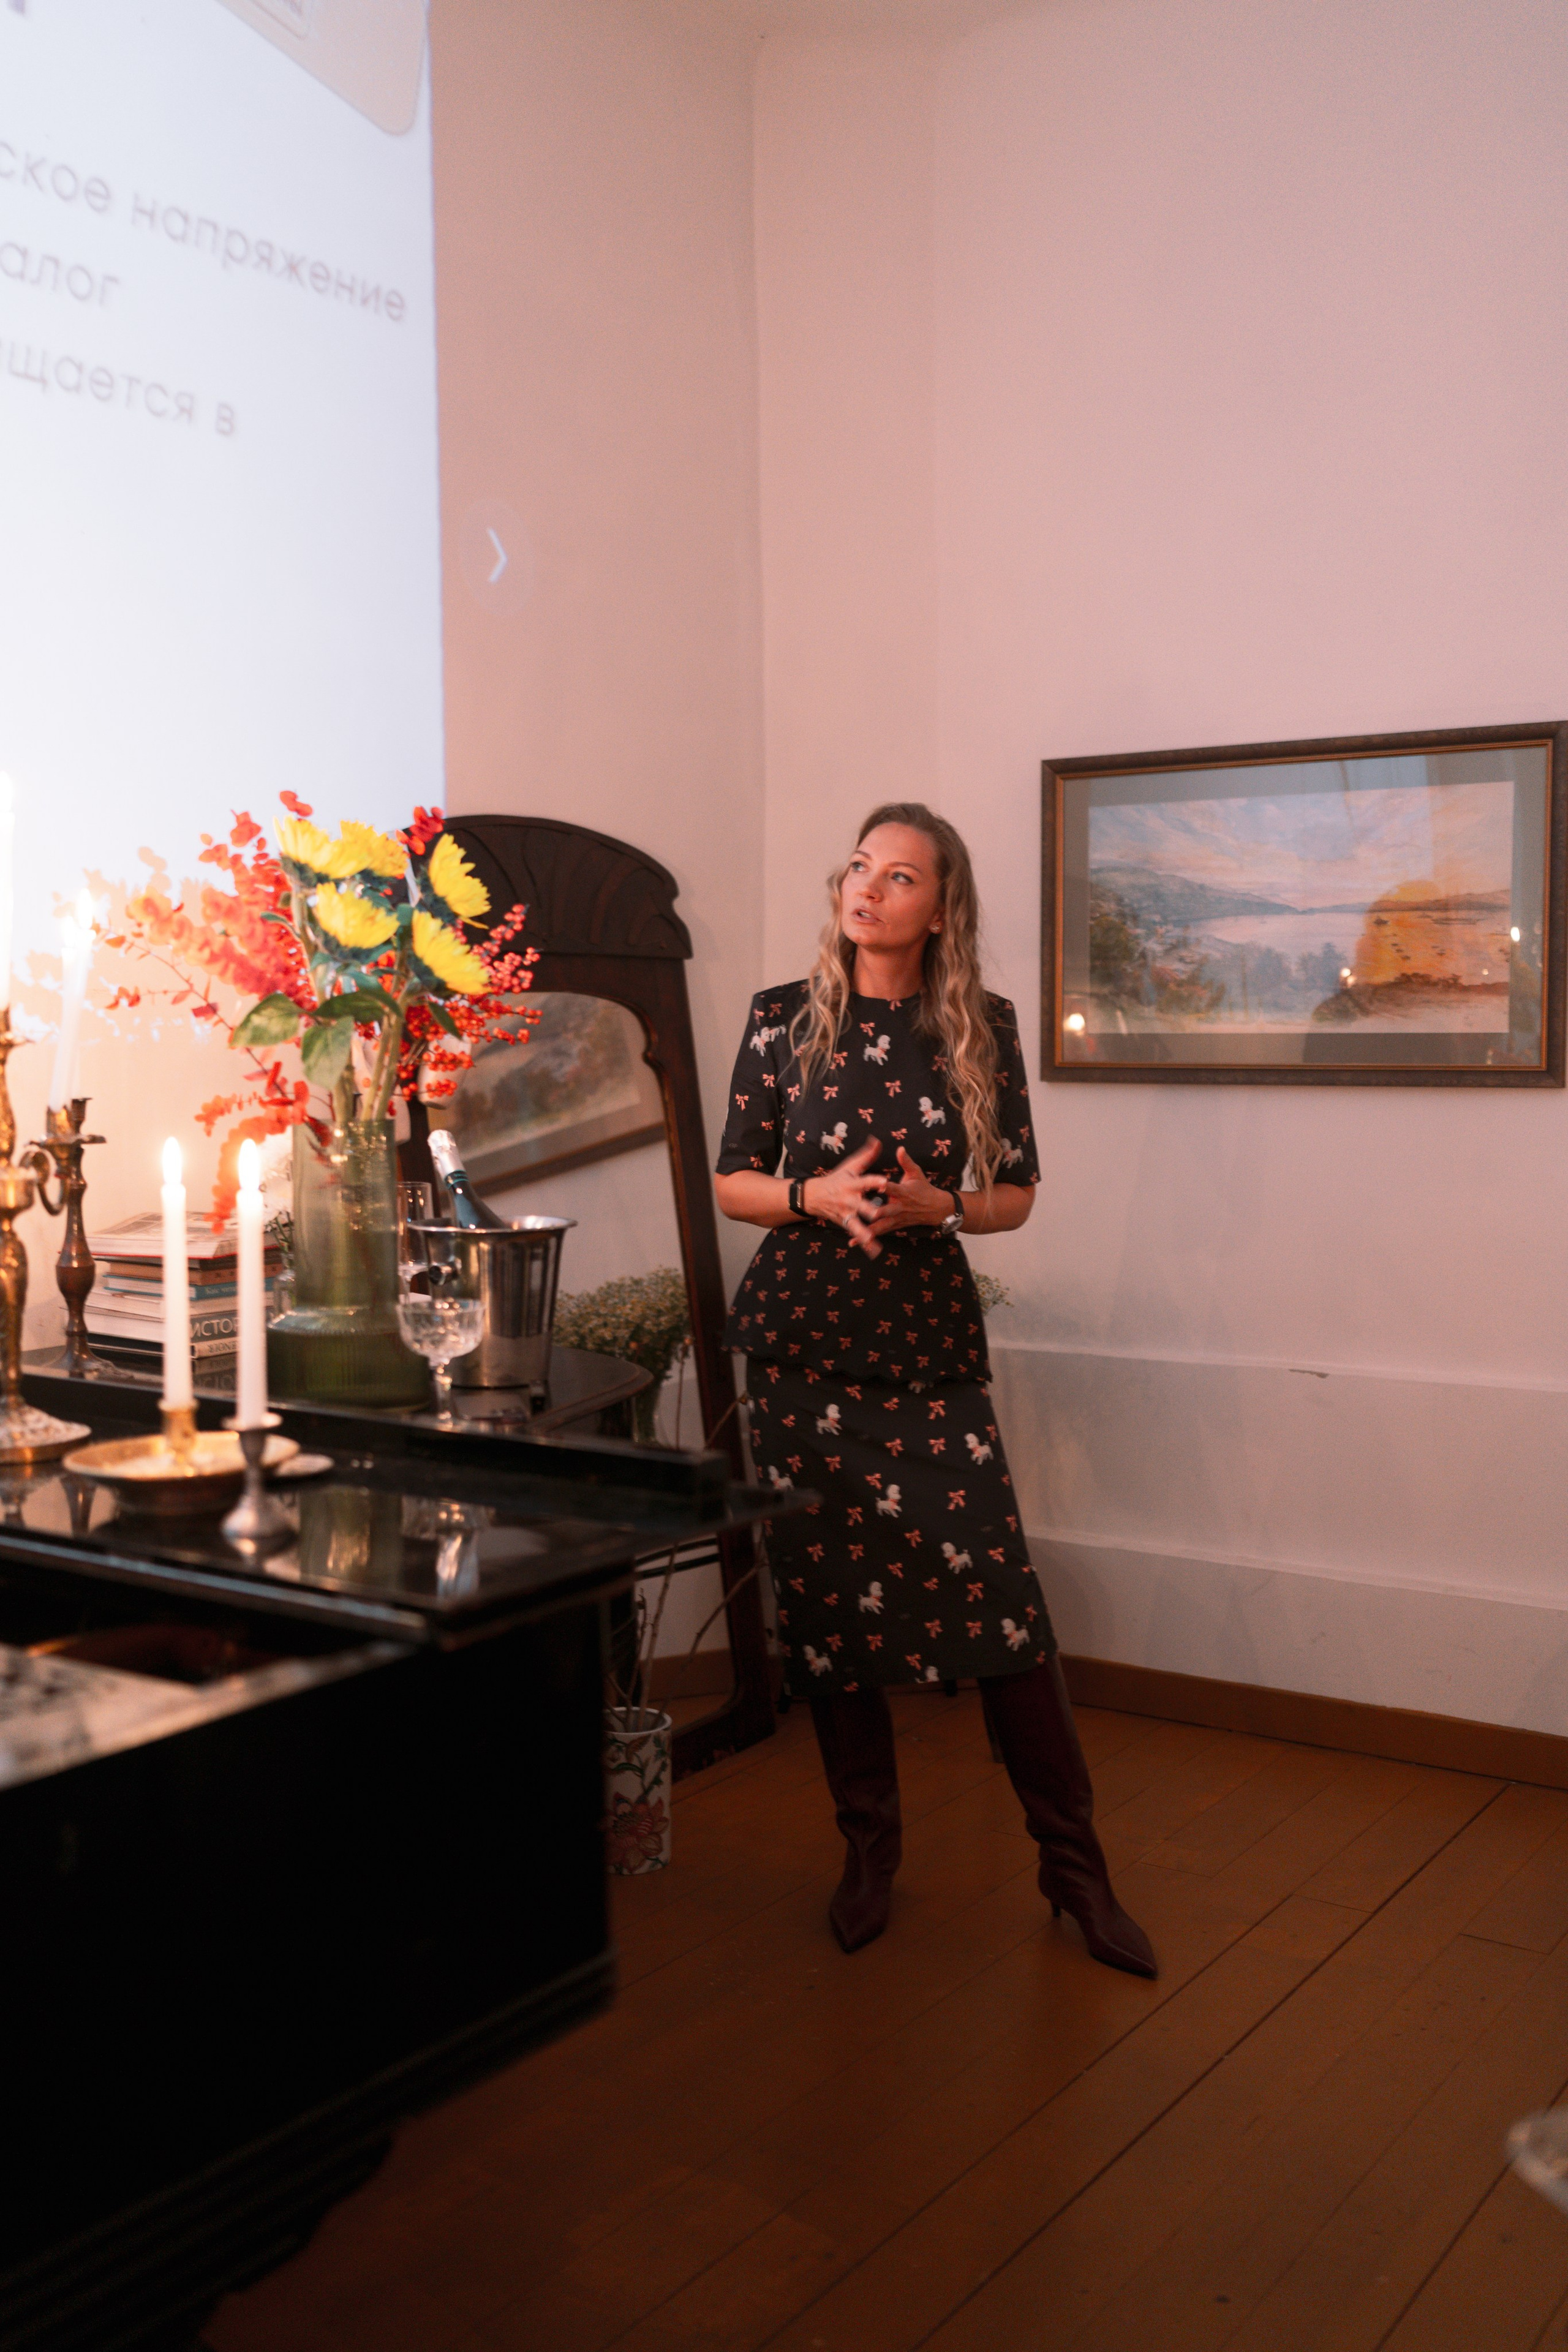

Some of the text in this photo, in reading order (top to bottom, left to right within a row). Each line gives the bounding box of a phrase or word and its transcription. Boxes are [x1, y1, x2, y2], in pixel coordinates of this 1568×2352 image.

[0, 242, 121, 307] алог
[130, 191, 407, 323] напряжение
[0, 337, 235, 437] щается в
